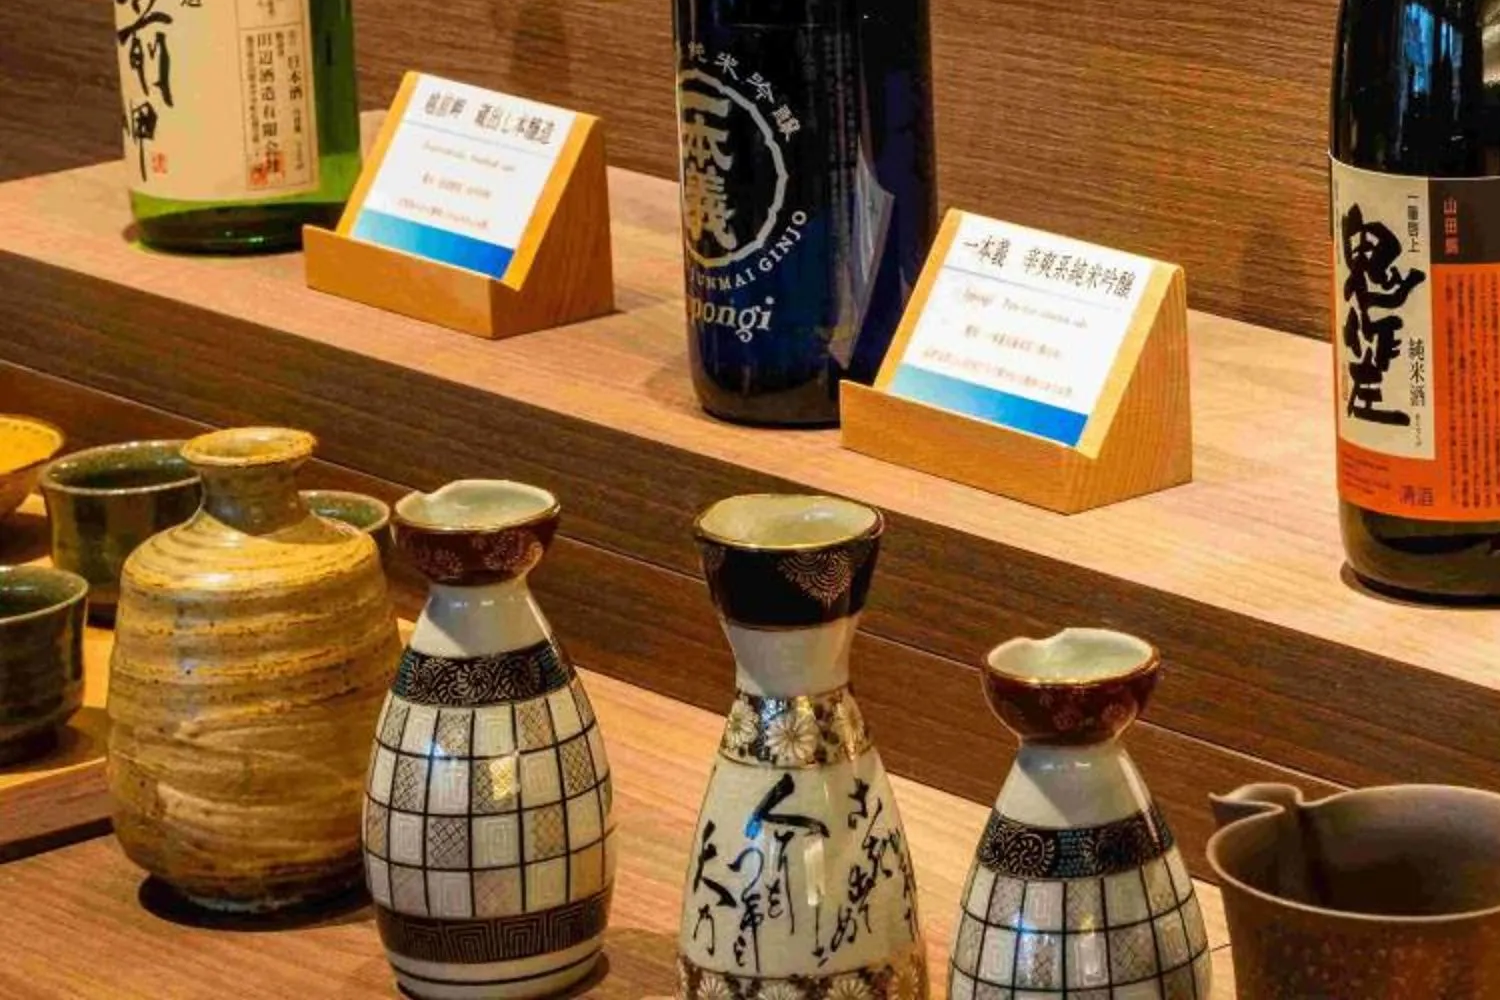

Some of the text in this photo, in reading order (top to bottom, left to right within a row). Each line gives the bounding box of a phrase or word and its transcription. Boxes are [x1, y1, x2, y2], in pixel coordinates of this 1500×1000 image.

[759, 211, 807, 272] GINJO
[1409, 338, 1425, 407] 純米酒
